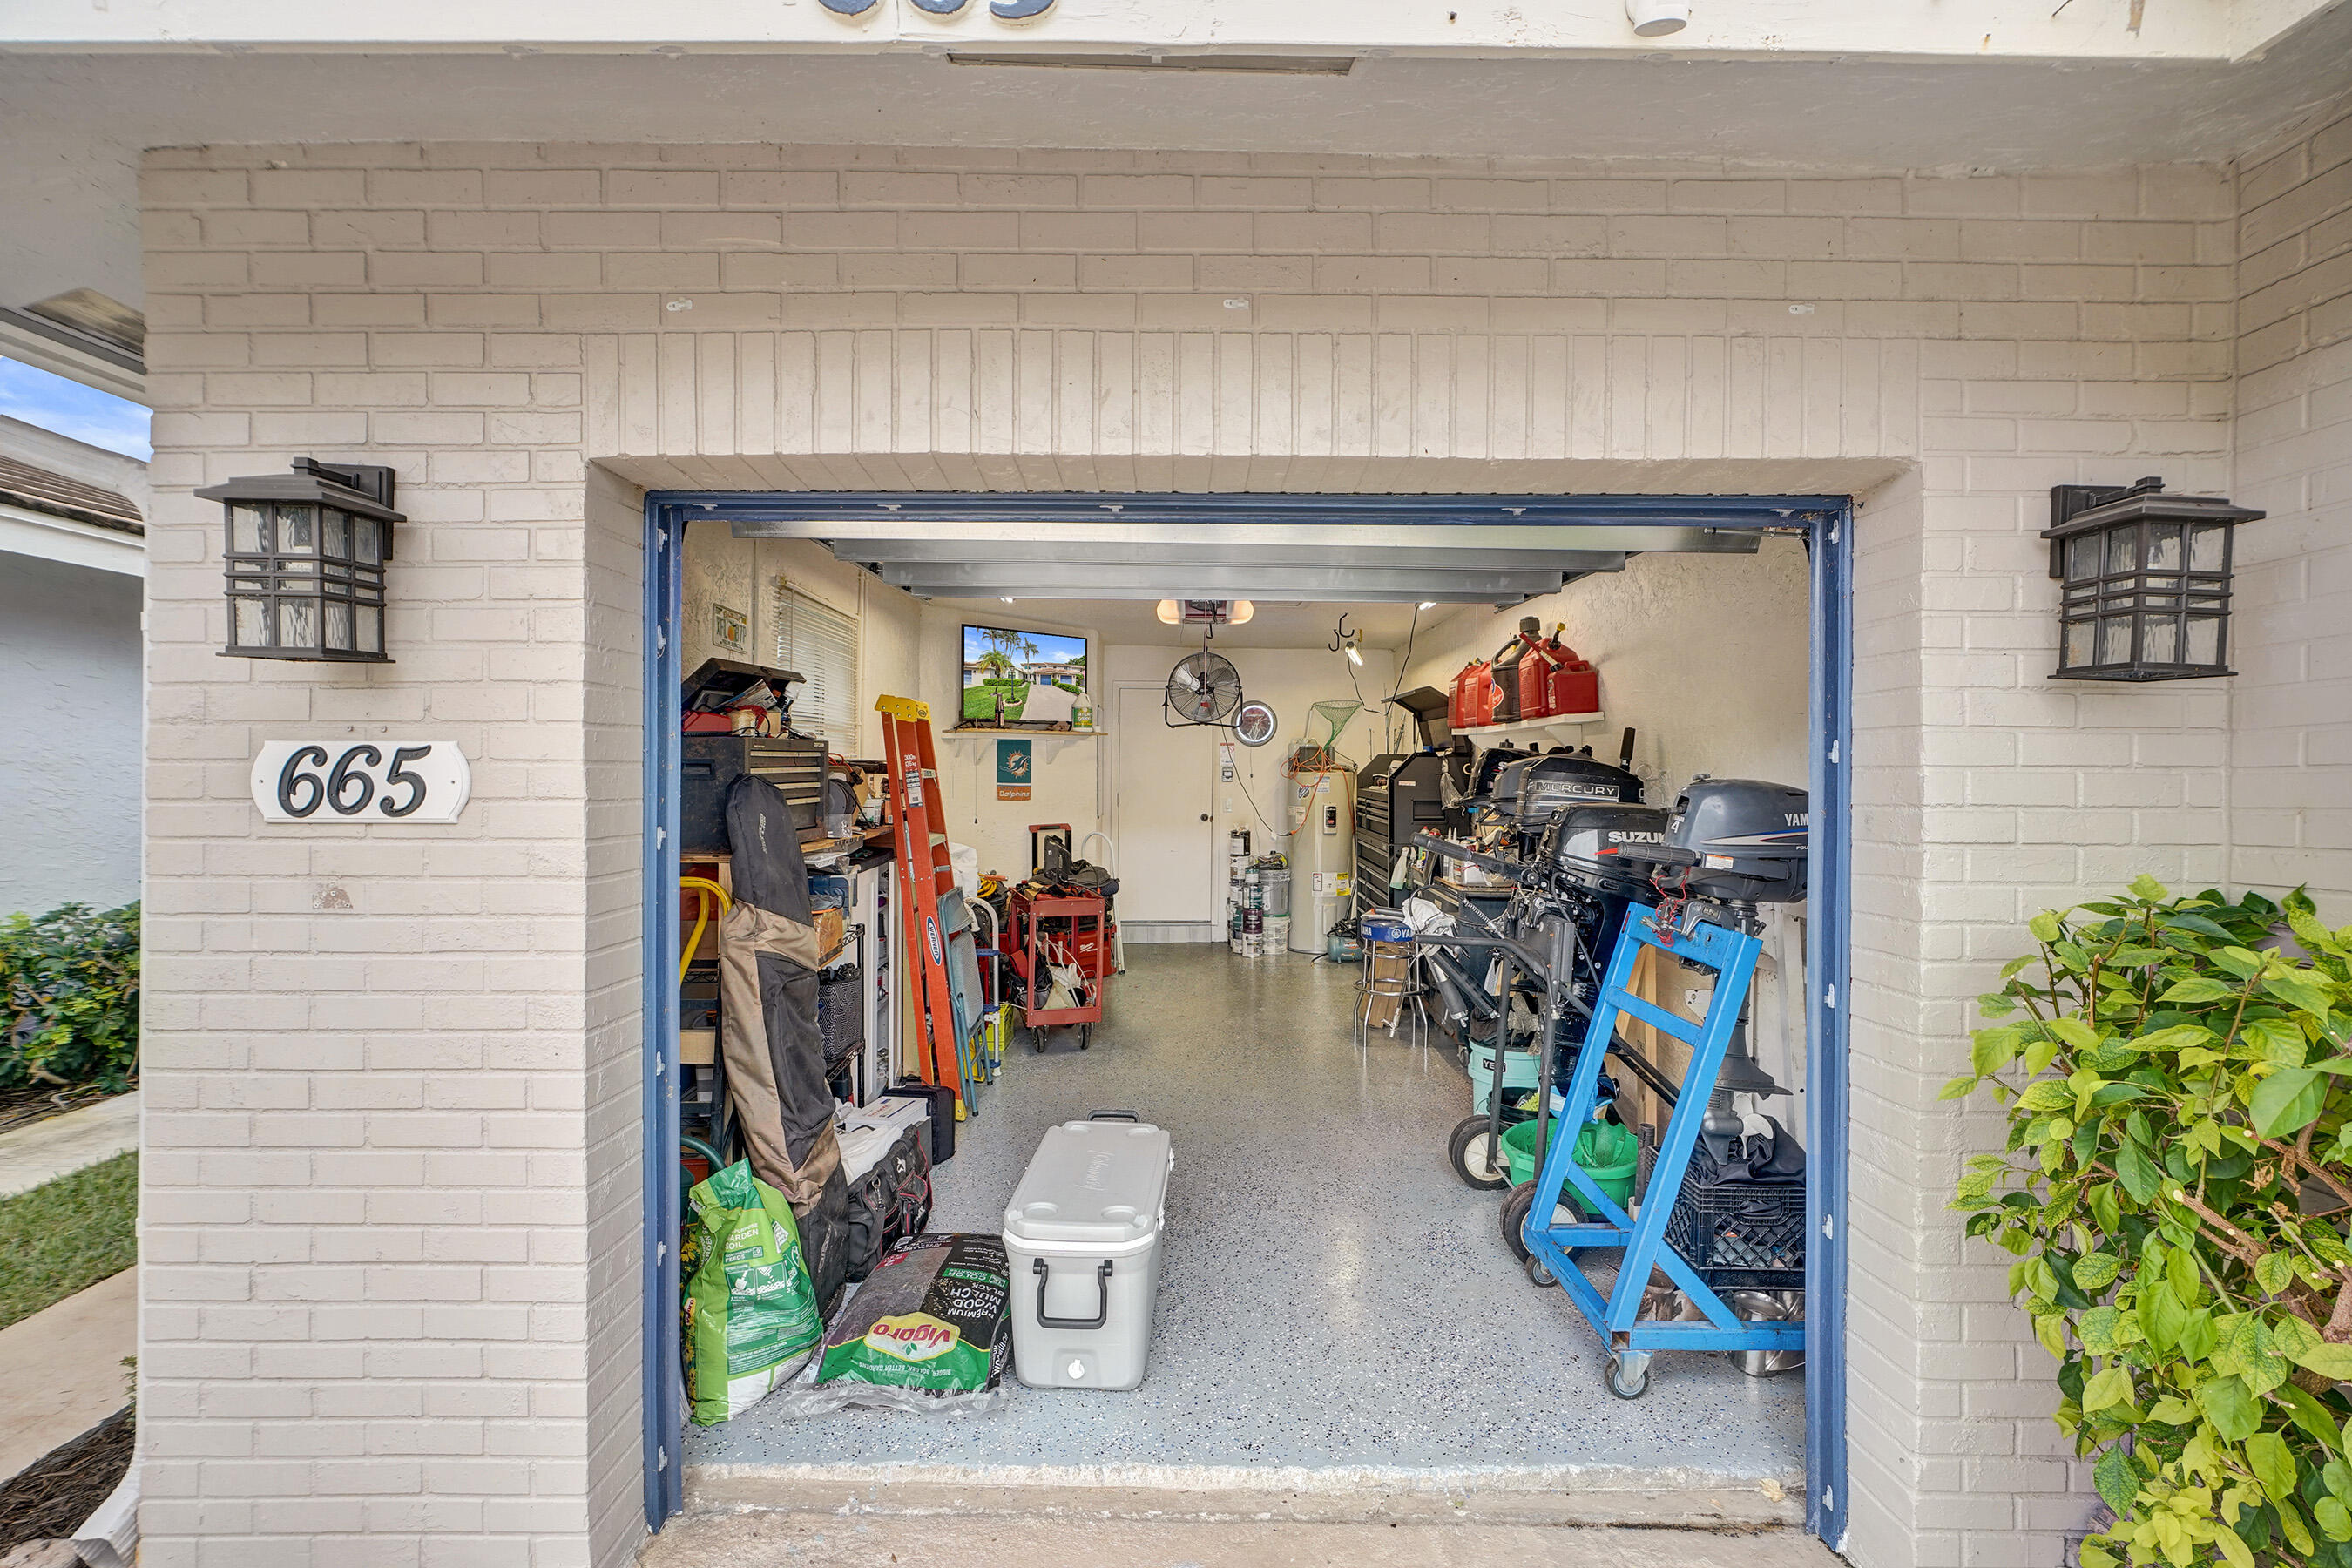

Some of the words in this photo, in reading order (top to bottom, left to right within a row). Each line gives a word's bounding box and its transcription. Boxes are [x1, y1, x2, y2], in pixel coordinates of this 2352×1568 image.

[276, 744, 432, 818] 665
[1535, 781, 1615, 795] MERCURY
[1785, 814, 1808, 826] YAM
[1670, 821, 1680, 833] 4
[1608, 831, 1665, 844] SUZUK
[929, 927, 939, 956] WERNER
[1484, 1060, 1505, 1071] YEI
[725, 1241, 744, 1250] SOIL
[725, 1254, 746, 1263] FEEDS
[948, 1271, 986, 1281] COLOR
[971, 1282, 1004, 1296] BLACK
[950, 1288, 1002, 1305] MULCH
[952, 1299, 997, 1314] WOOD
[947, 1308, 994, 1319] PREMIUM
[873, 1323, 950, 1348] Vigoro
